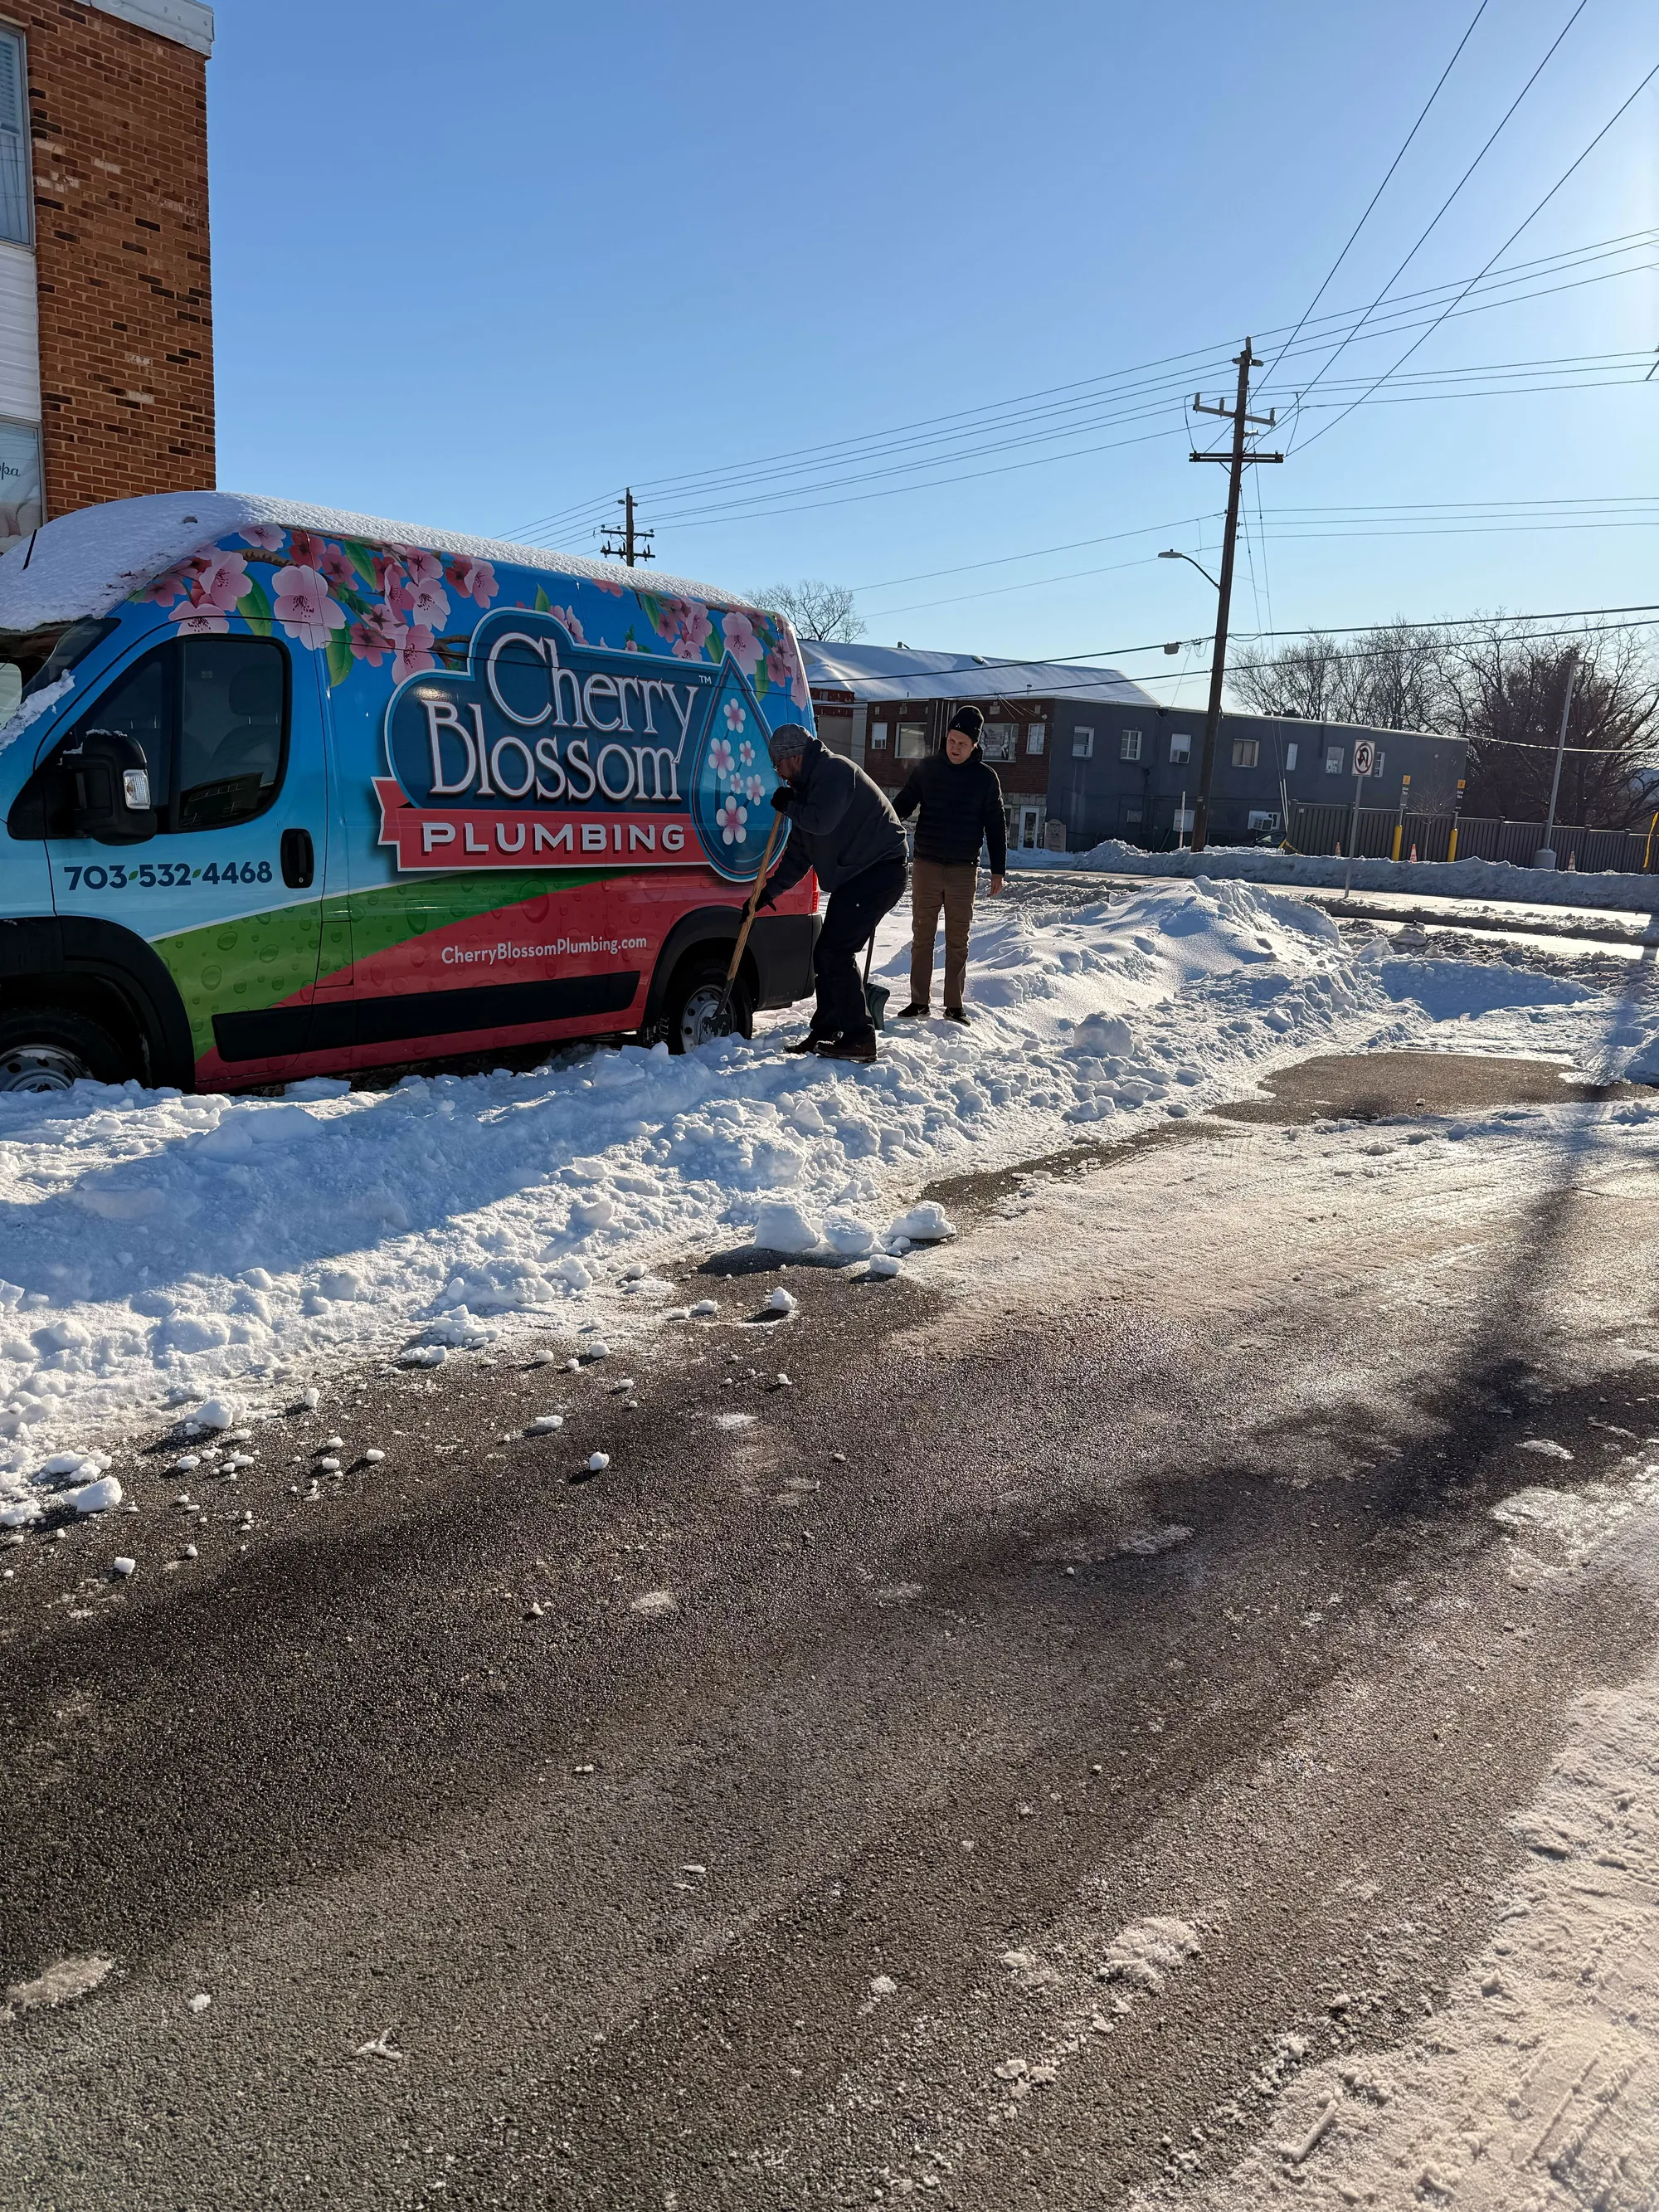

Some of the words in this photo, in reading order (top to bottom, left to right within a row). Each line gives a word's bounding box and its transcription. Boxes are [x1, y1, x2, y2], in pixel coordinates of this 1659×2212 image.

[0, 461, 21, 480] pa
[486, 632, 698, 764] Cherry
[421, 699, 683, 801] Blossom
[422, 821, 685, 852] PLUMBING
[441, 935, 647, 965] CherryBlossomPlumbing.com
